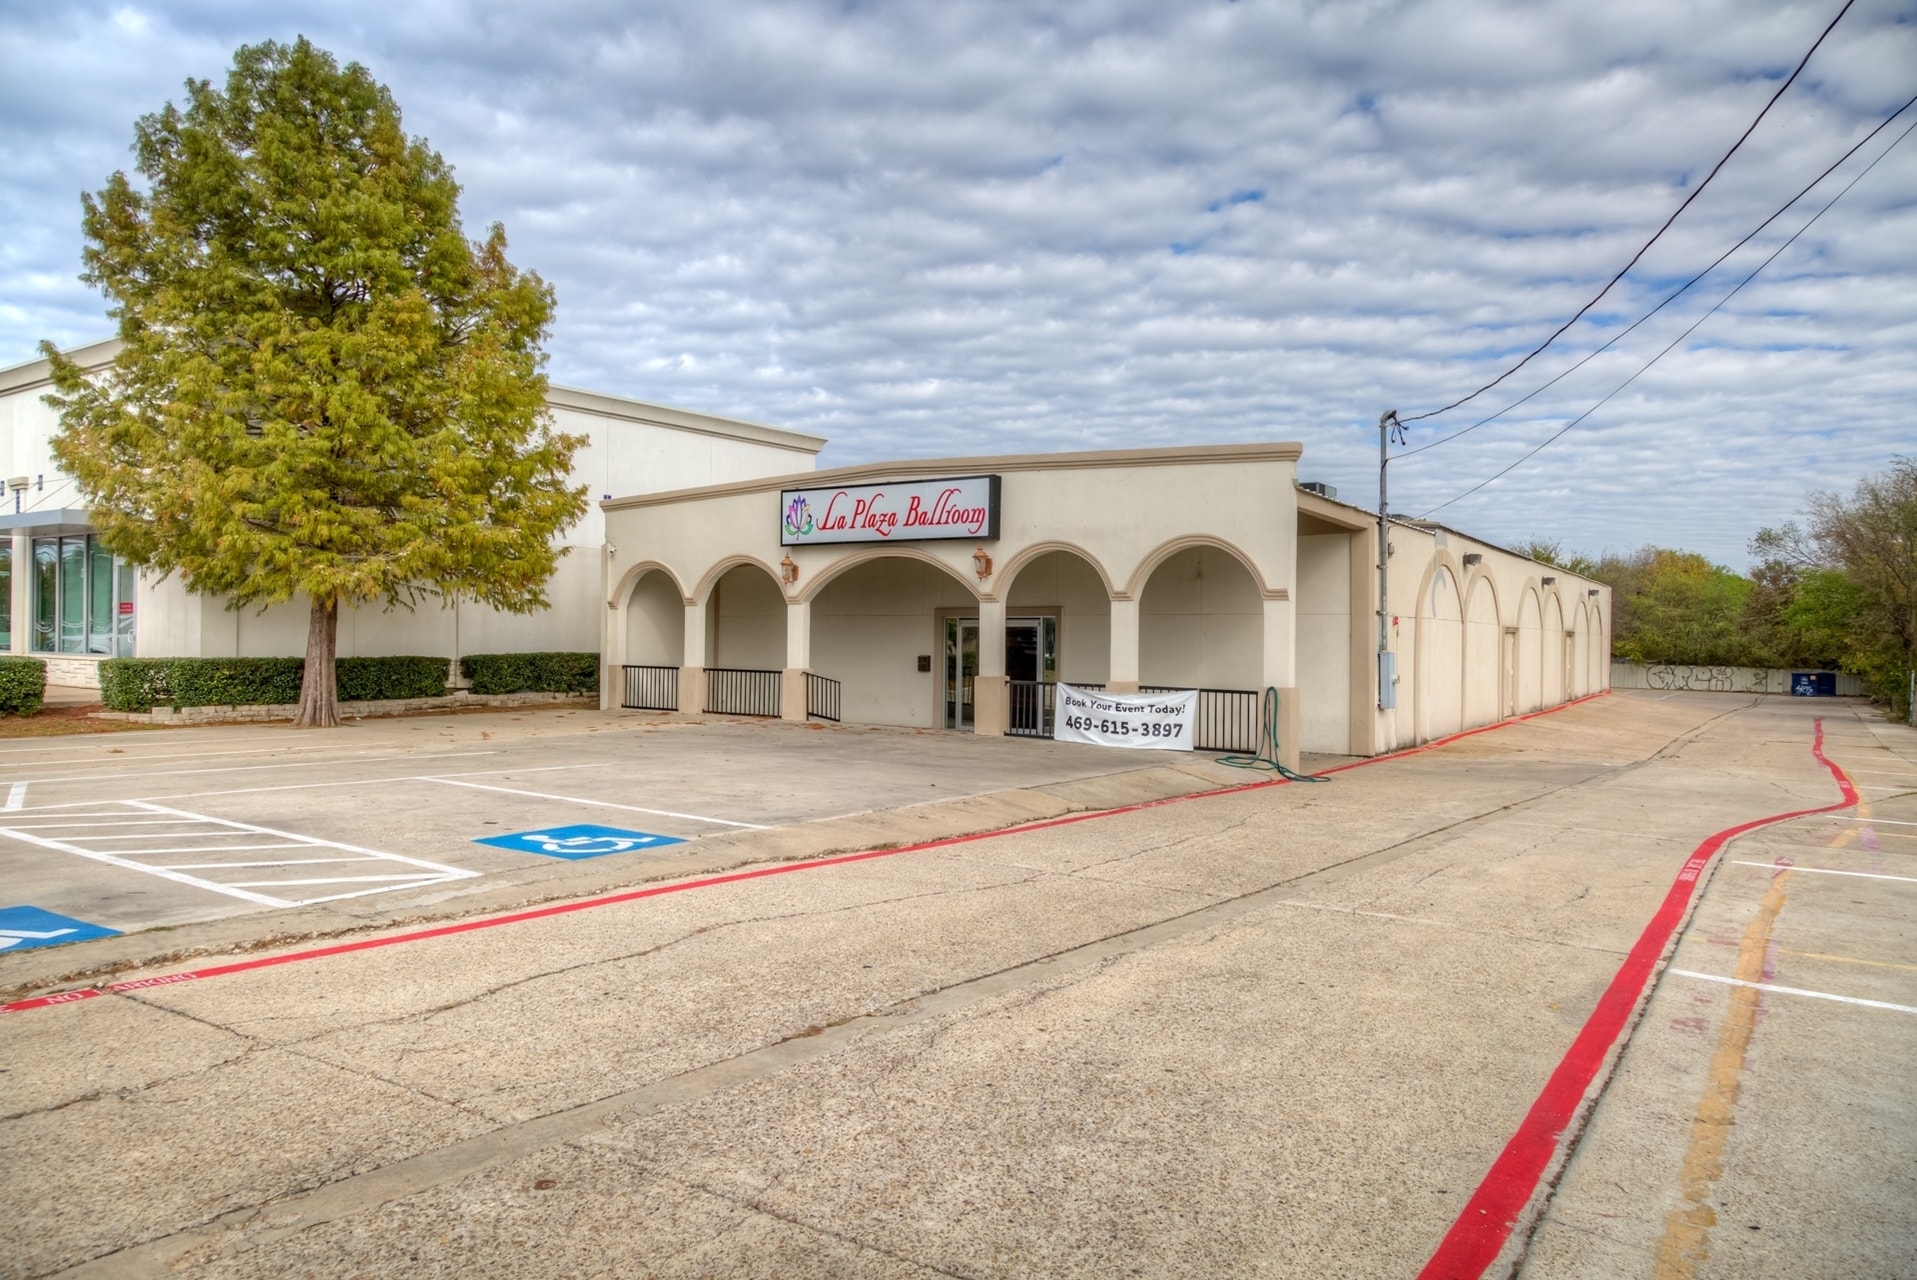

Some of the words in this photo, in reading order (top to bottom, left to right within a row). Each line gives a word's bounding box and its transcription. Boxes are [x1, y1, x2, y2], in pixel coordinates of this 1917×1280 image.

[816, 491, 848, 530] La
[849, 493, 898, 537] Plaza
[903, 488, 986, 534] Ballroom
[1065, 696, 1087, 708] Book
[1090, 700, 1112, 712] Your
[1115, 703, 1145, 714] Event
[1147, 704, 1186, 716] Today!
[1065, 715, 1184, 738] 469-615-3897
[47, 992, 84, 1004] NO
